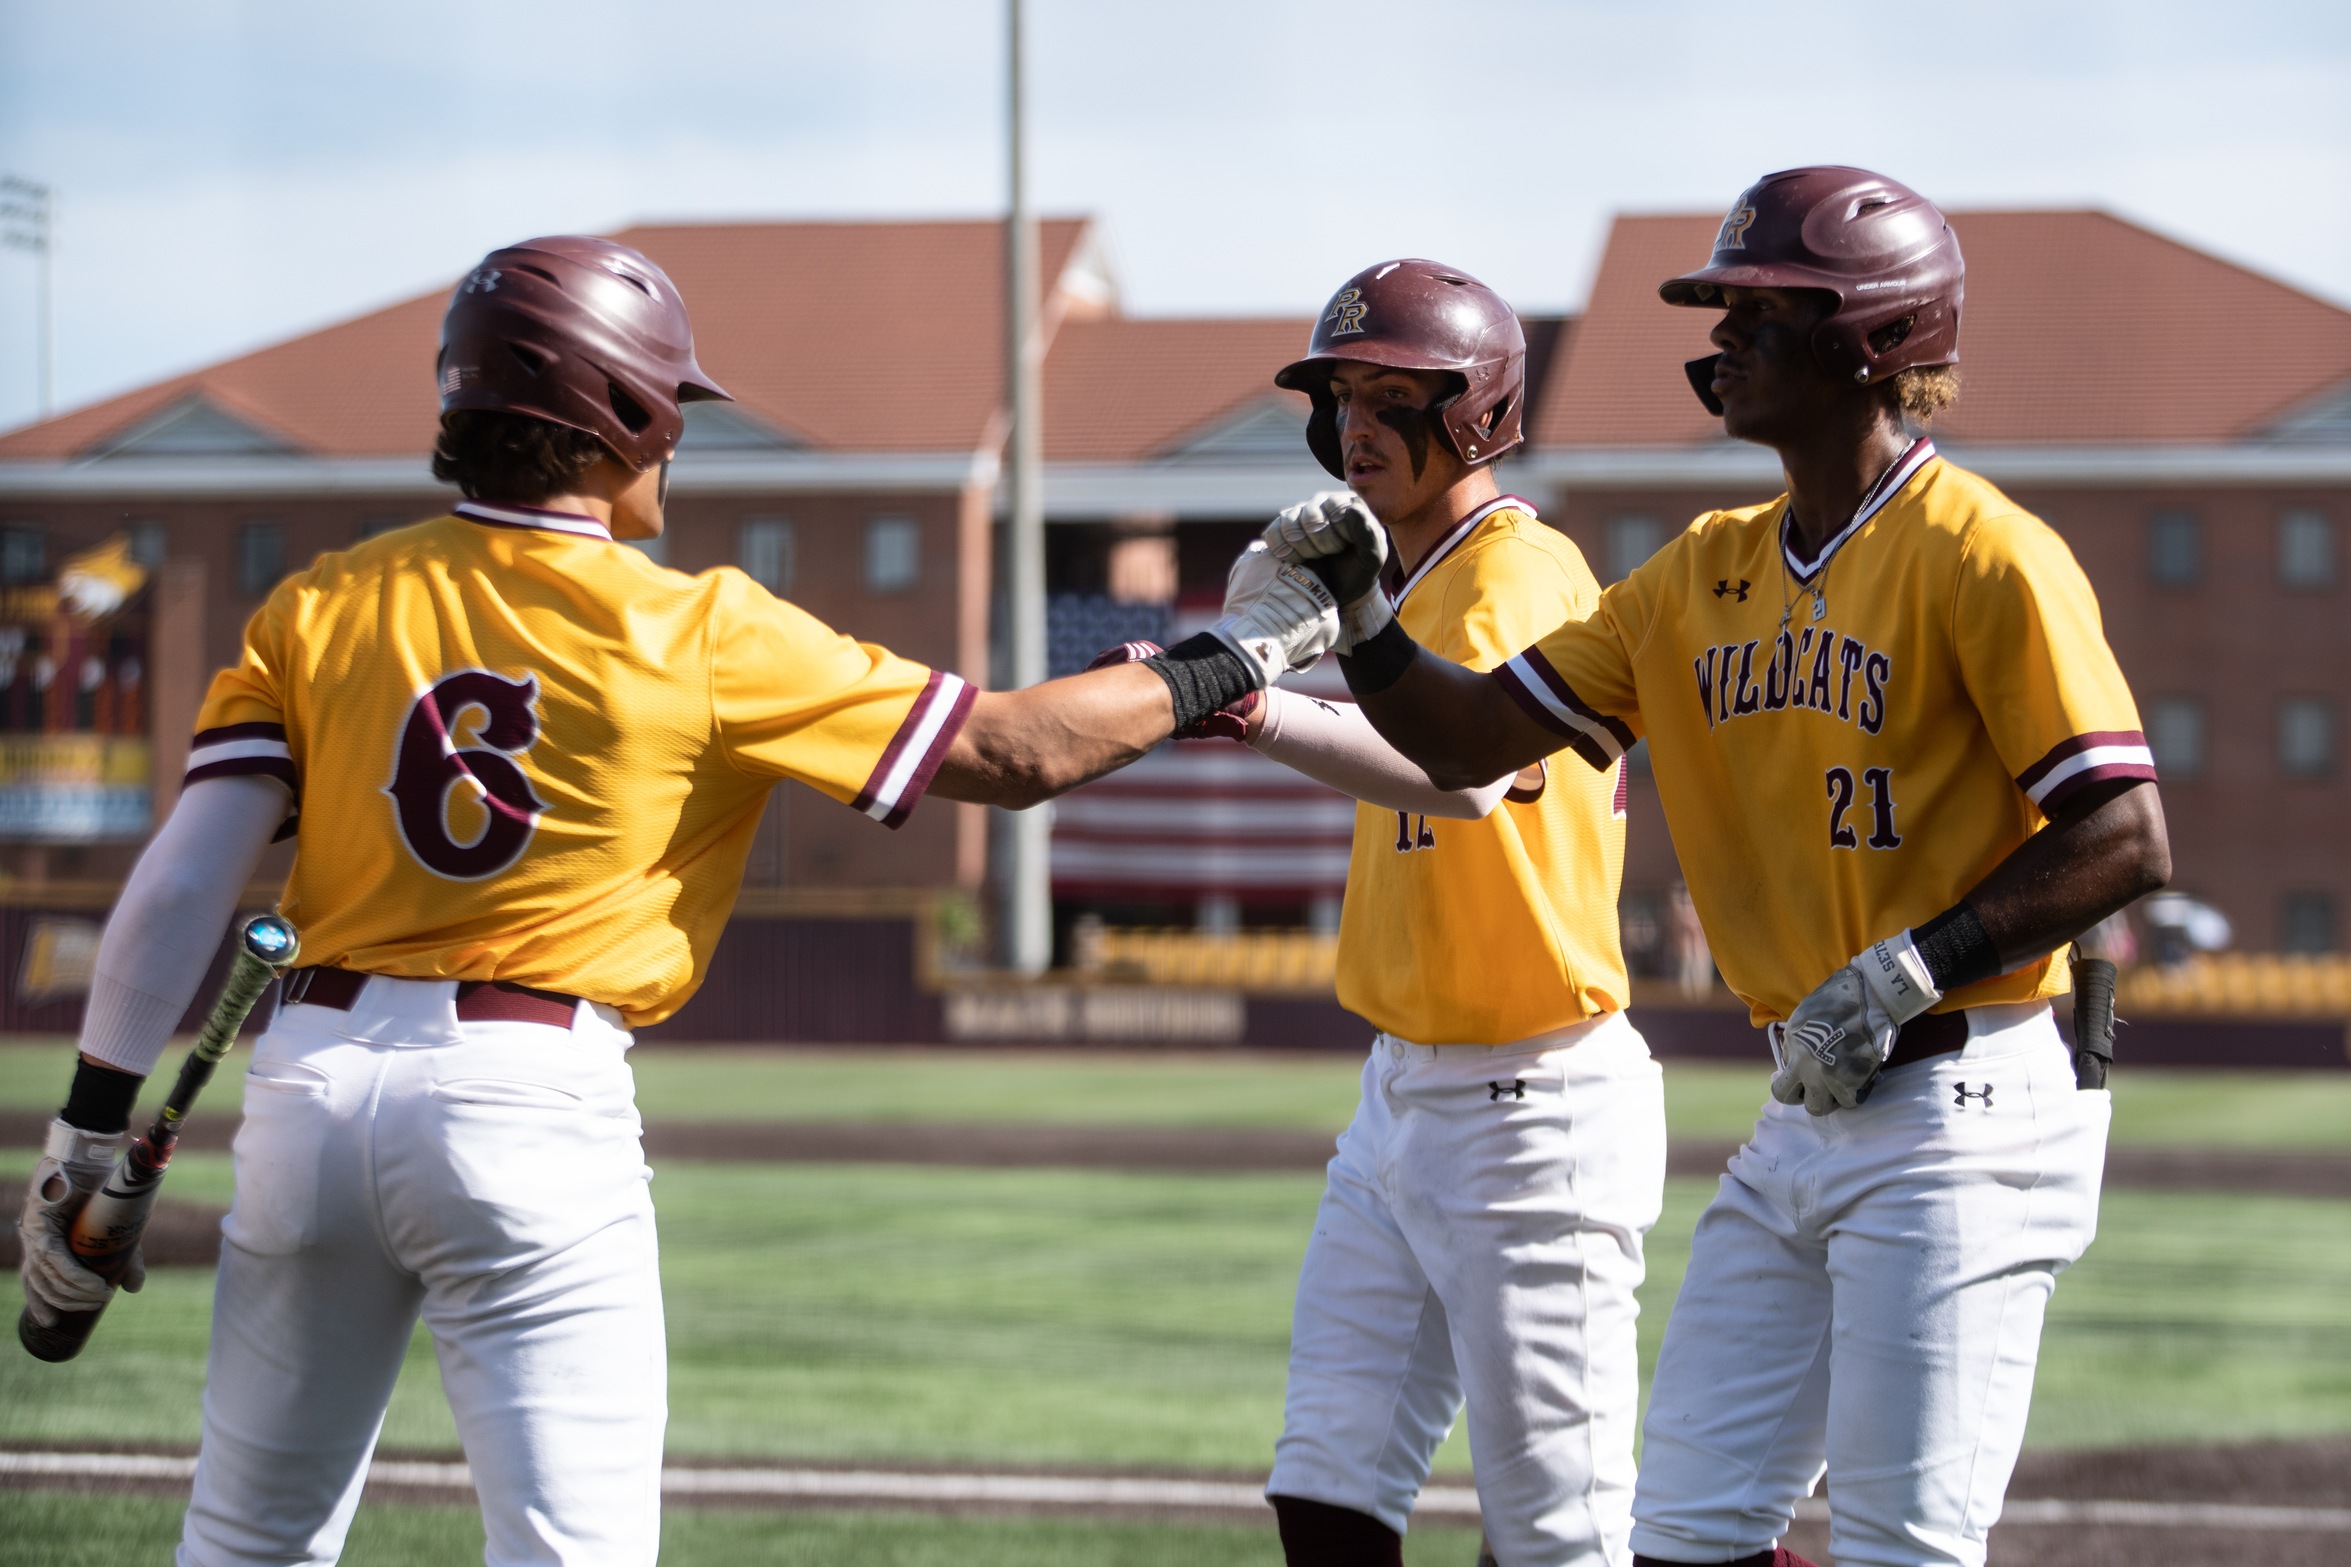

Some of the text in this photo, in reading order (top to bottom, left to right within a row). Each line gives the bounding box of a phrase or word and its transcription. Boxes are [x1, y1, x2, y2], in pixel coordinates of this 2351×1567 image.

[1324, 288, 1369, 338] PR
[1855, 280, 1906, 291] UNDER ARMOUR
[1694, 626, 1891, 736] WILDCATS
[379, 667, 556, 883] 6
[1825, 765, 1902, 851] 21
[1890, 972, 1910, 996] LA
